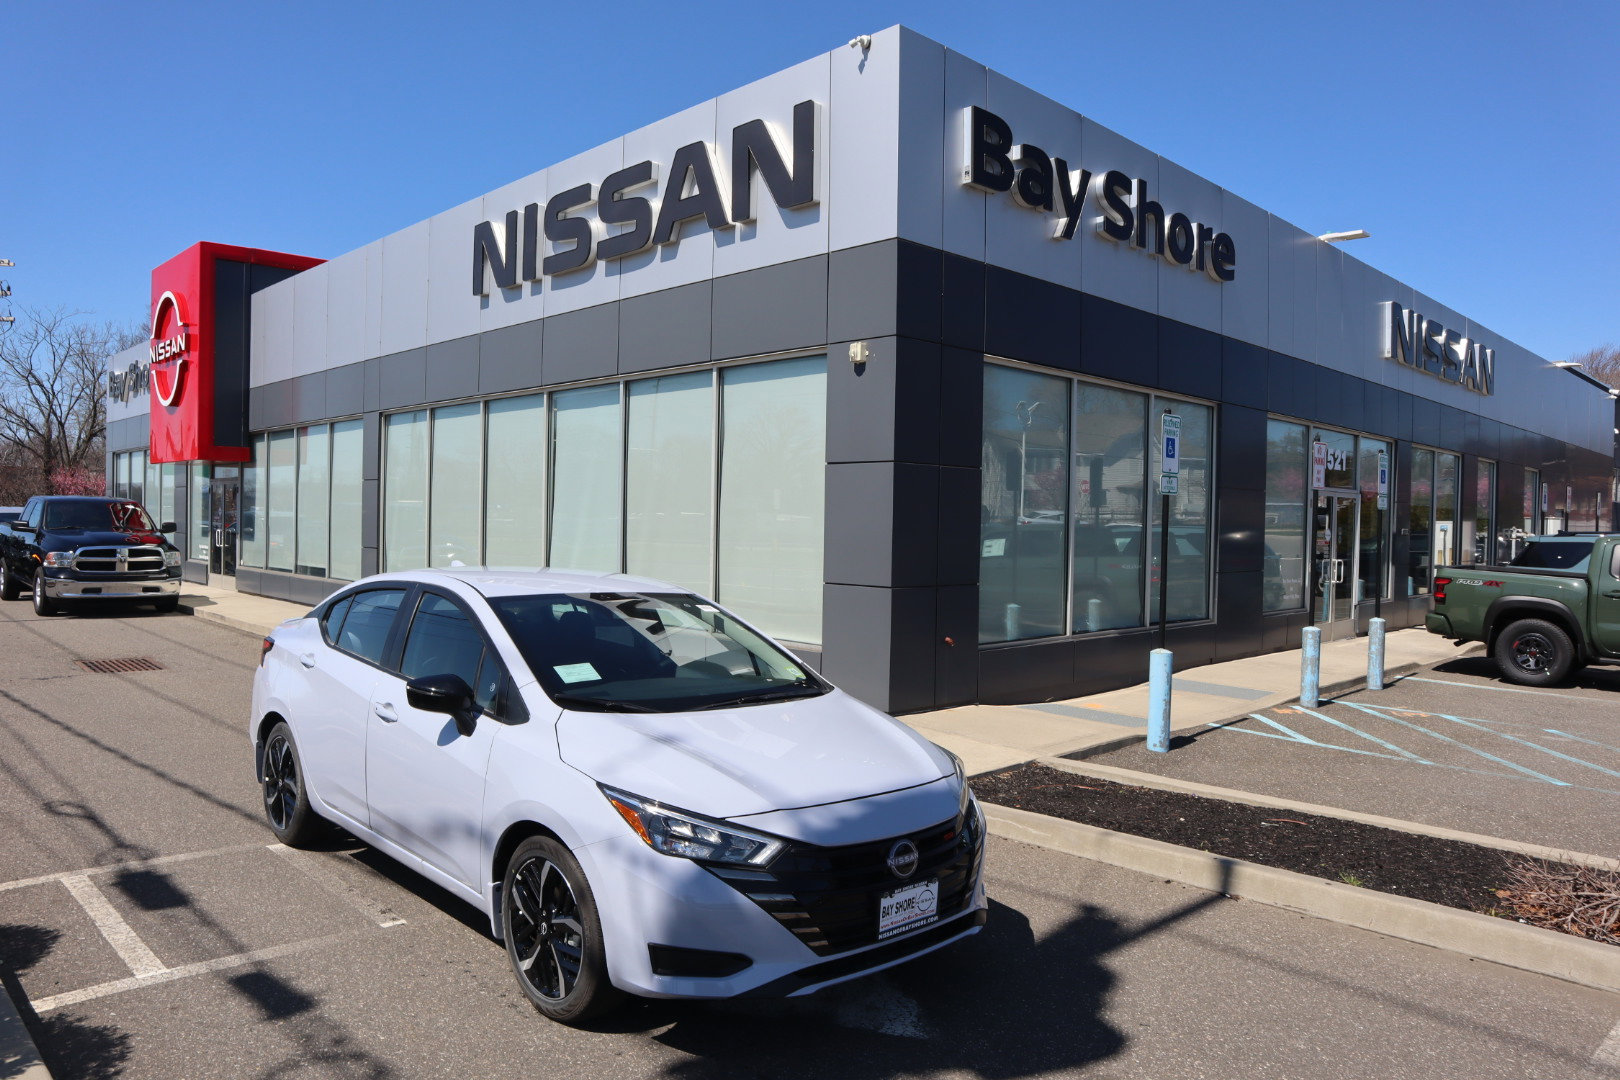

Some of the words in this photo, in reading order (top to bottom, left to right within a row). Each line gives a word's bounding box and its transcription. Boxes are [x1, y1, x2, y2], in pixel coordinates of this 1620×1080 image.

[473, 99, 820, 297] NISSAN
[962, 105, 1092, 240] Bay
[1095, 170, 1236, 282] Shore
[150, 332, 186, 363] NISSAN
[1385, 301, 1495, 396] NISSAN
[128, 360, 150, 392] Sho
[887, 852, 918, 866] NISSAN
[882, 904, 895, 918] BAY
[895, 897, 915, 914] SHORE
[917, 896, 936, 906] NISSAN
